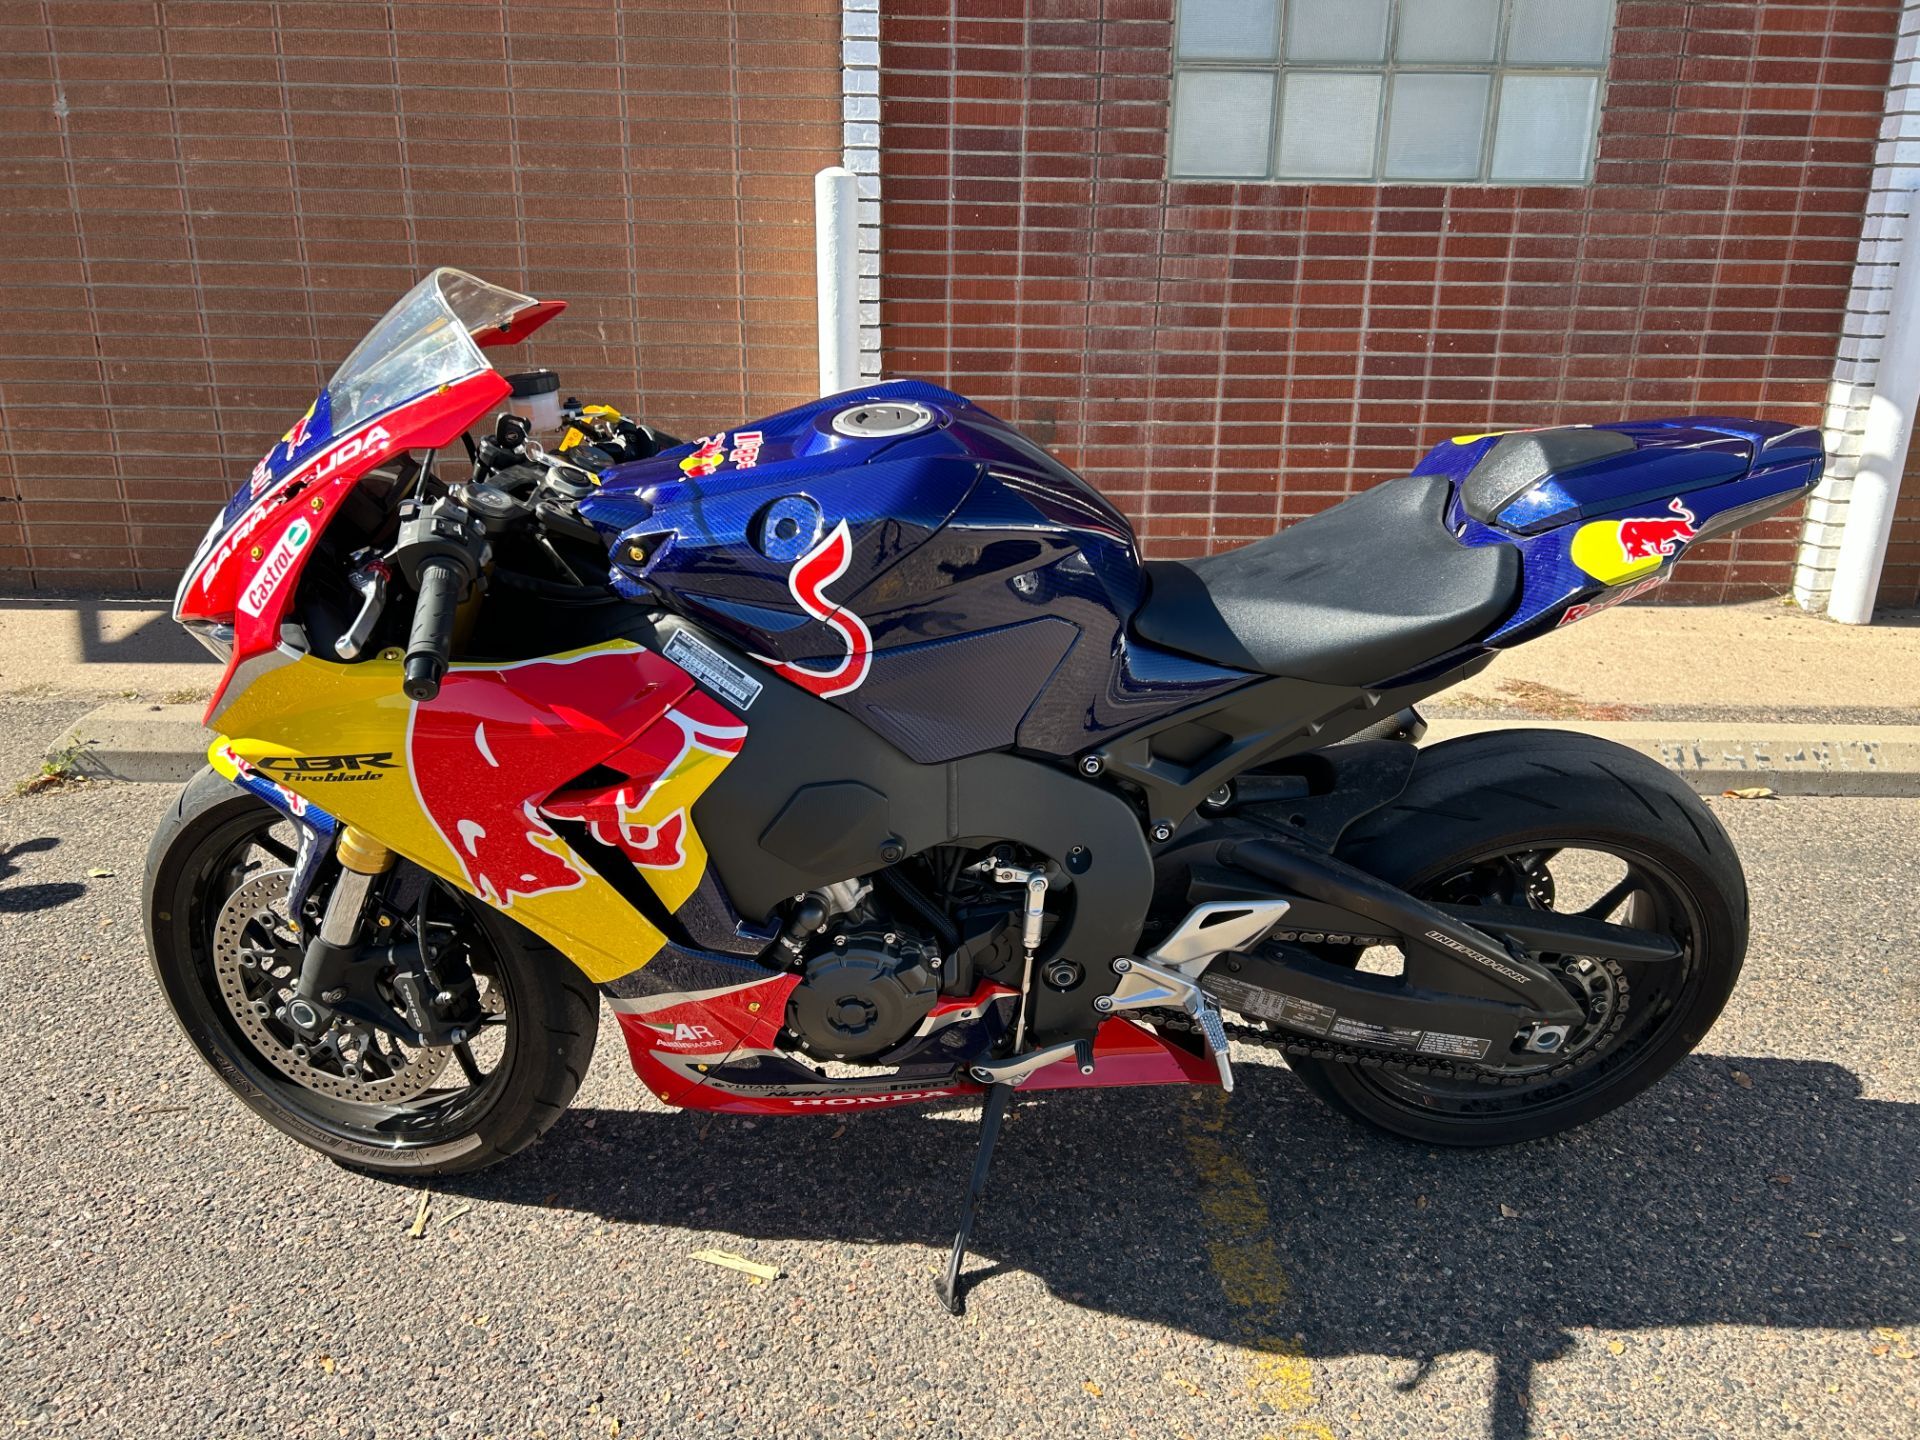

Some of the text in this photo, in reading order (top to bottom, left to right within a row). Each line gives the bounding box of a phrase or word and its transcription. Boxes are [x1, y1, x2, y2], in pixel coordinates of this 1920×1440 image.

[248, 543, 295, 611] Castrol
[256, 752, 403, 771] CBR
[282, 771, 384, 783] Fireblade
[403, 983, 422, 1028] TOKICO
[675, 1023, 715, 1041] AR
[726, 1083, 788, 1091] YUTAKA
[789, 1090, 953, 1107] HONDA
